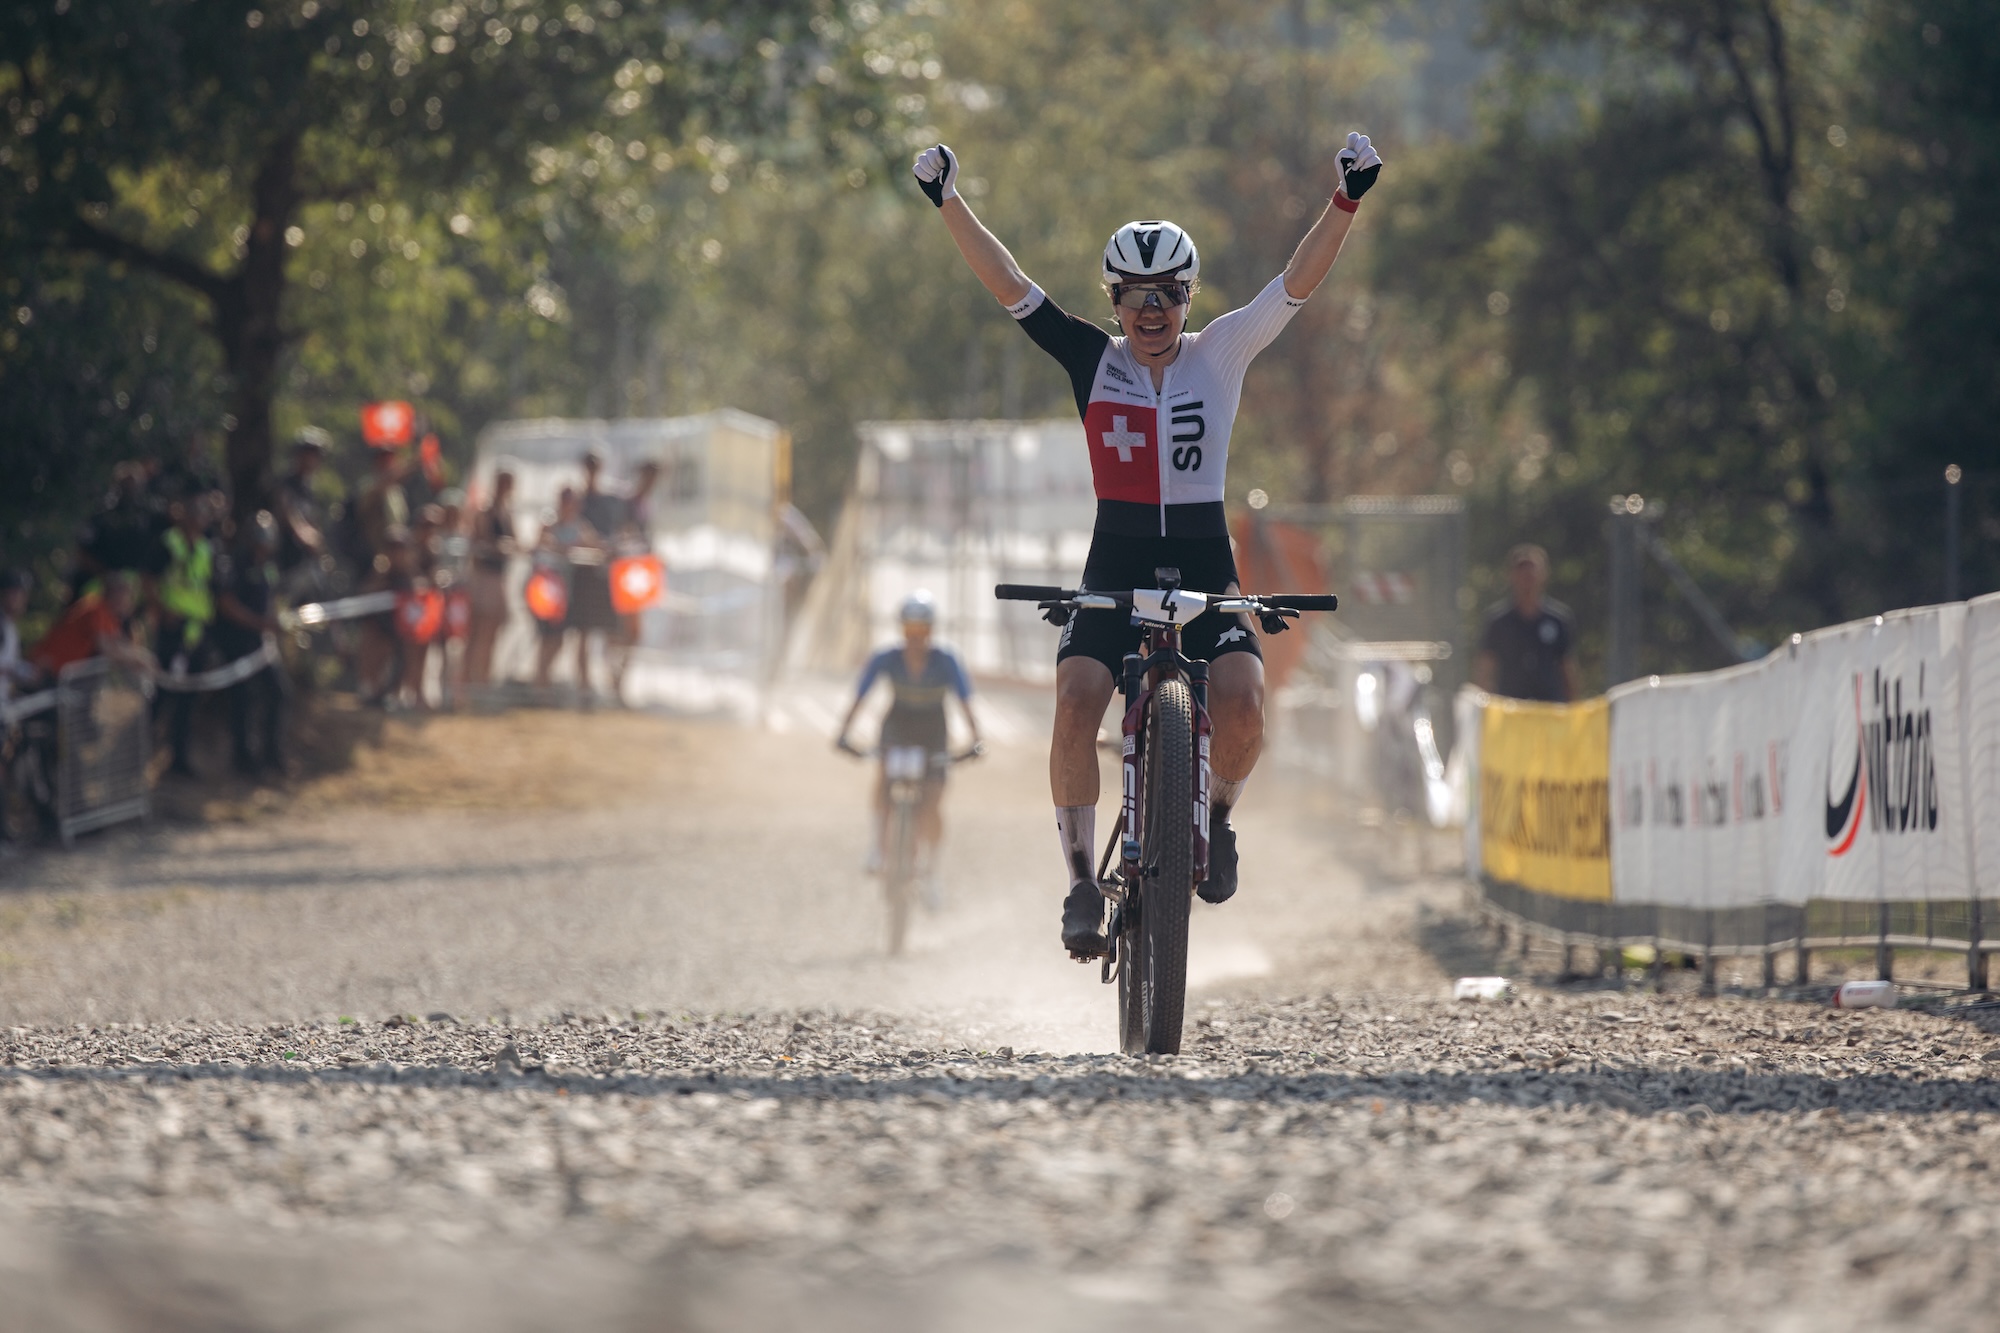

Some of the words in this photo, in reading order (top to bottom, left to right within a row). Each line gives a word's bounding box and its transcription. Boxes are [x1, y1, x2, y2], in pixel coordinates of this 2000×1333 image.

[1106, 369, 1134, 385] CYCLING
[1171, 400, 1205, 472] SUI
[1161, 590, 1177, 621] 4
